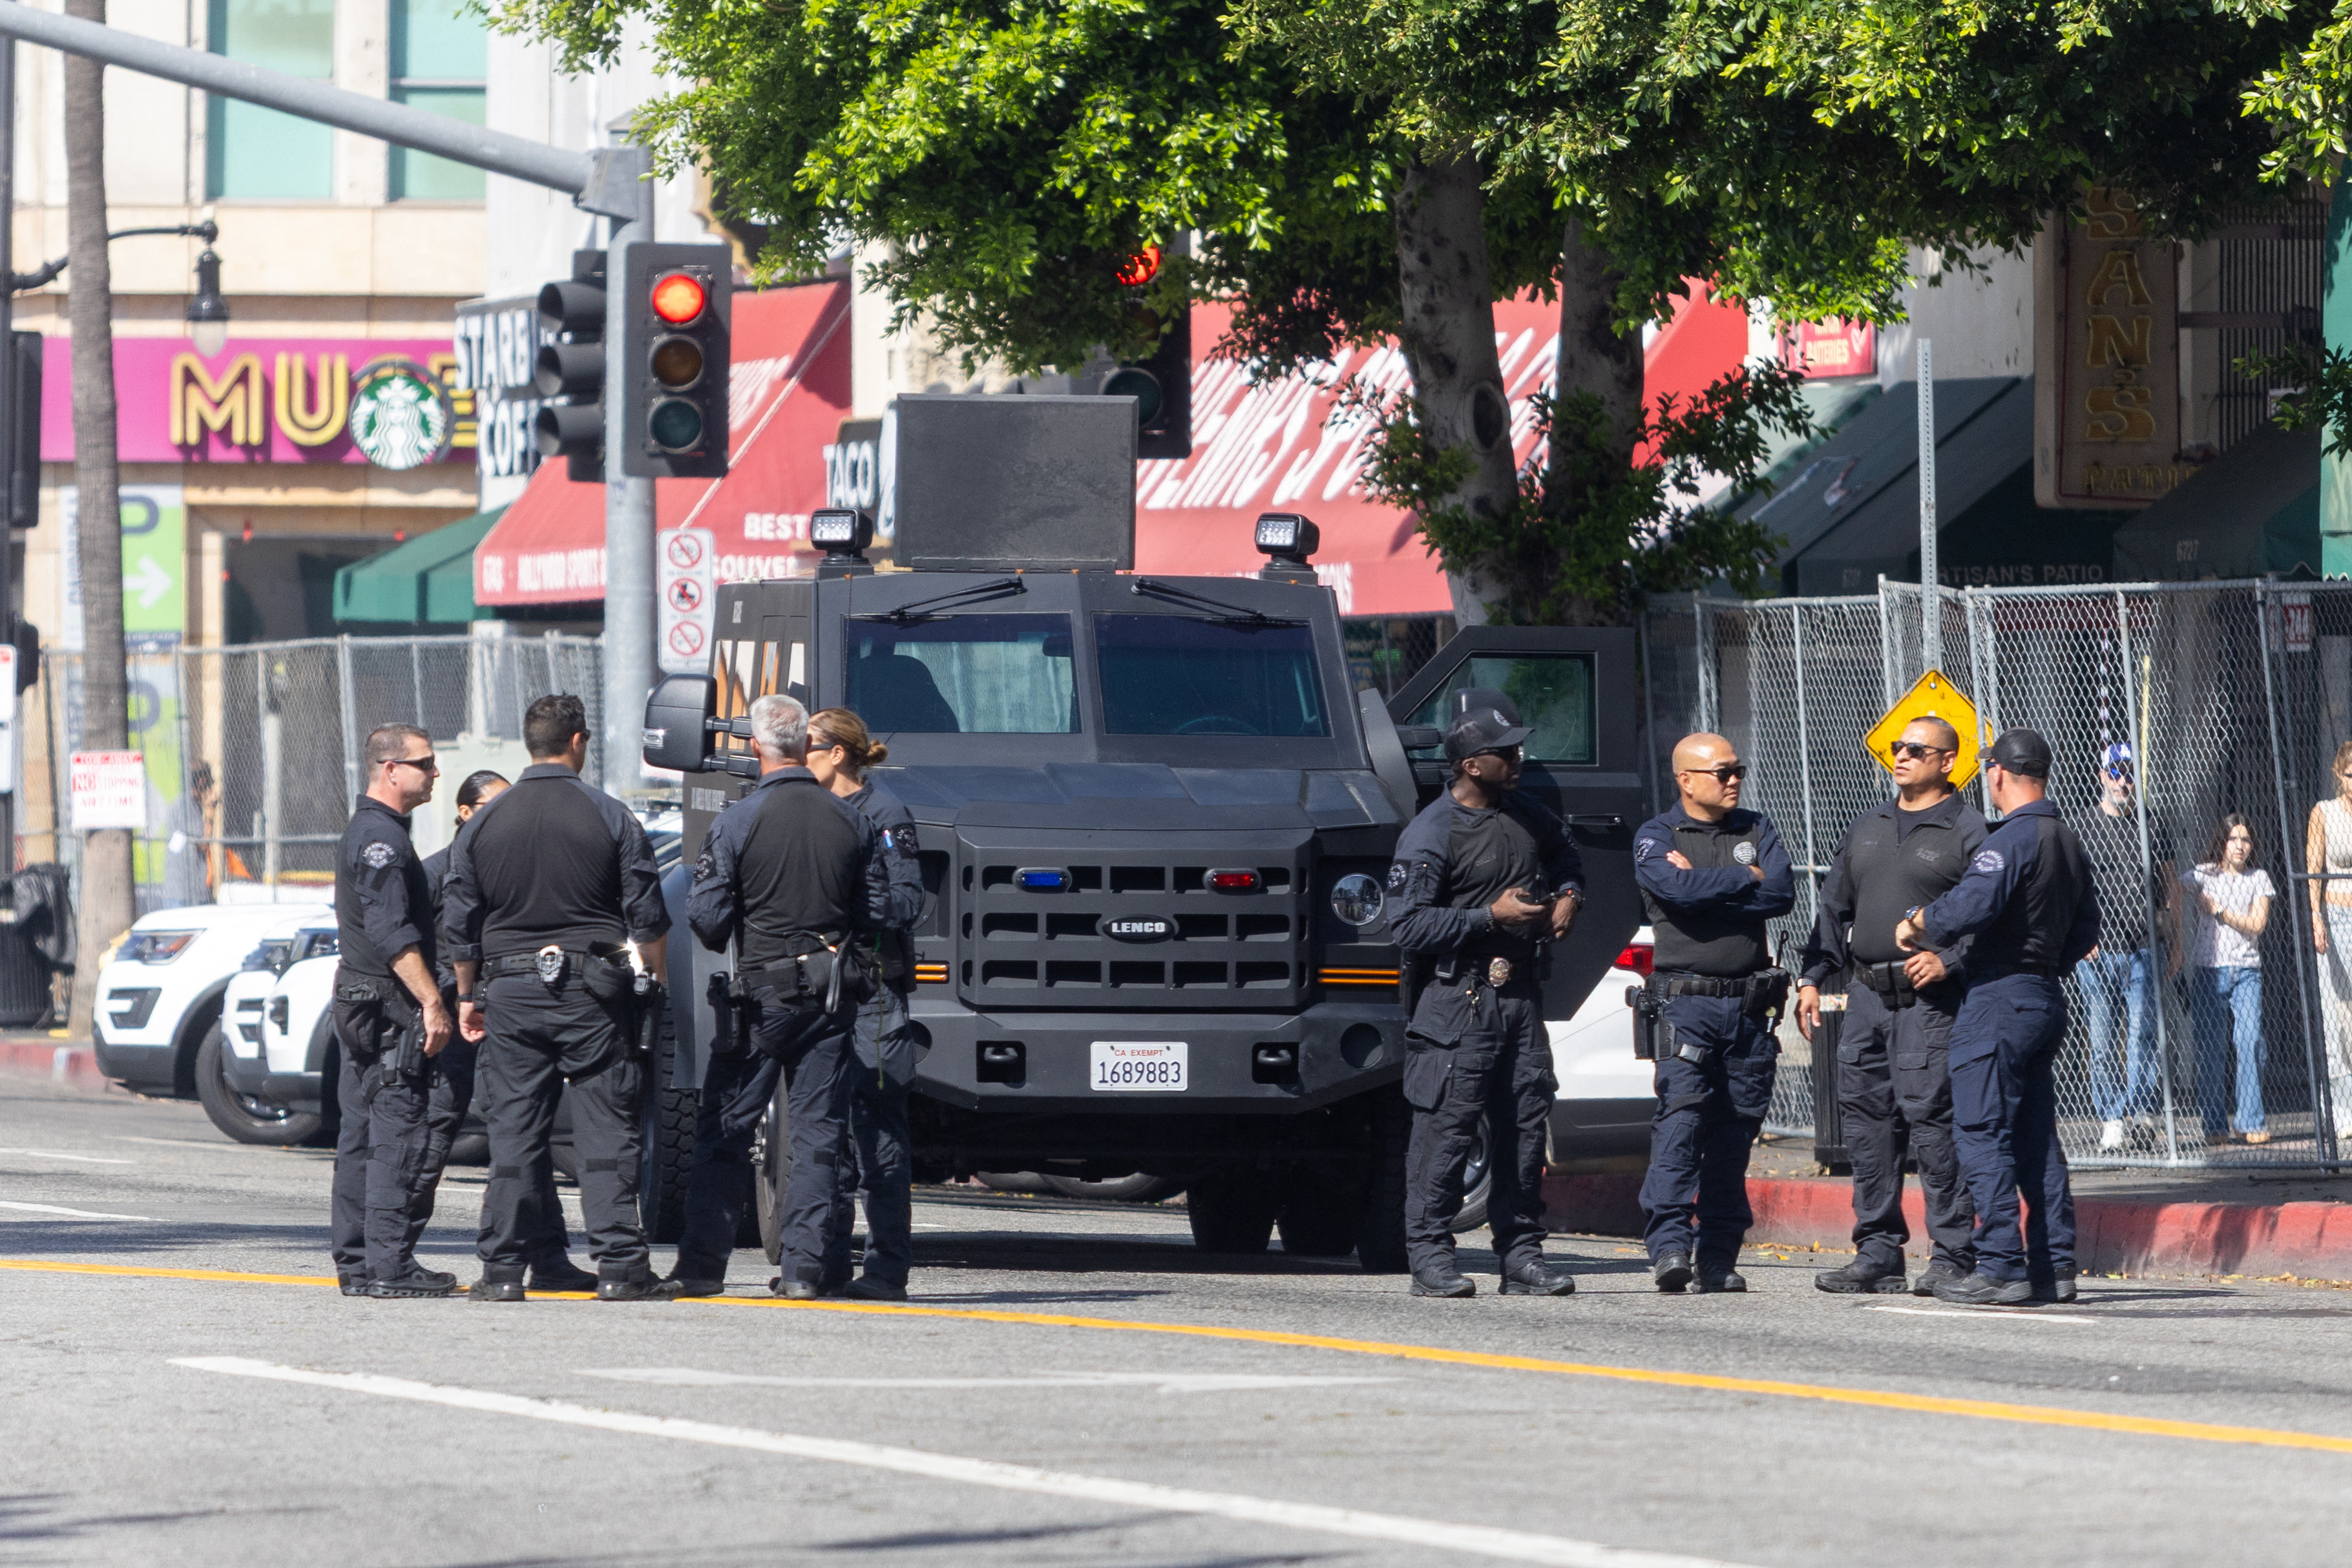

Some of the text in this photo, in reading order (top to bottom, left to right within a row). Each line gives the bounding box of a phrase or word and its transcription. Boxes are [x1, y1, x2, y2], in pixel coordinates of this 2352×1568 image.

[454, 308, 572, 390] STARB
[479, 398, 570, 476] COF
[823, 441, 875, 508] TACO
[2083, 464, 2200, 491] PATI
[744, 512, 808, 541] BEST
[1938, 565, 2103, 583] RTISAN'S PATIO
[74, 774, 140, 791] NO STOPPING
[1974, 850, 2004, 868] LOS ANGELES
[1976, 862, 1994, 872] POLICE
[1111, 922, 1165, 932] LENCO
[1098, 1061, 1181, 1083] 1689883
